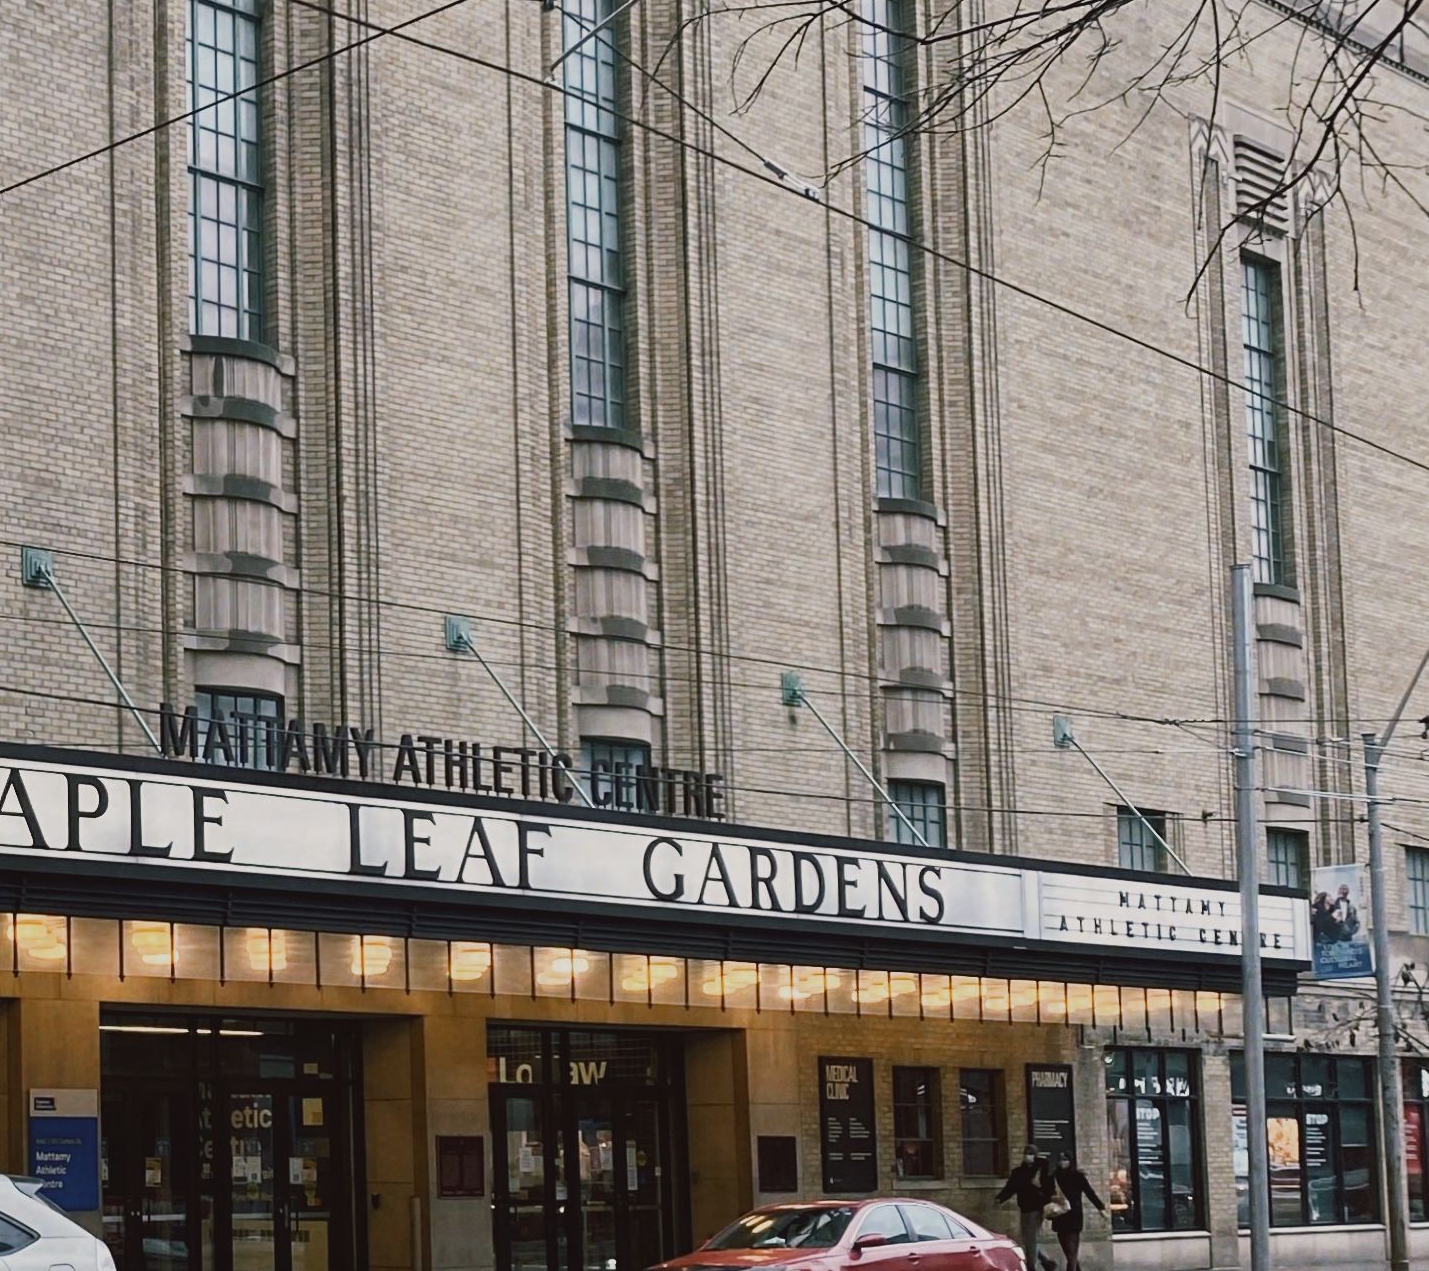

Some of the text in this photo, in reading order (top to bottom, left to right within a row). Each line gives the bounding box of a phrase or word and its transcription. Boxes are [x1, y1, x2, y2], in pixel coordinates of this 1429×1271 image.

[160, 702, 725, 819] MATTAMY ATHLETIC CENTRE
[347, 802, 553, 890] LEAF
[642, 837, 946, 925] GARDENS
[1118, 891, 1226, 917] MATTAMY
[1059, 915, 1282, 949] ATHLETIC CENRE
[826, 1065, 858, 1083] MEDICAL
[1031, 1071, 1068, 1088] PHARMACY
[826, 1083, 850, 1100] CLINIC
[36, 1152, 71, 1162] Mattamy
[36, 1165, 67, 1175] Athletic
